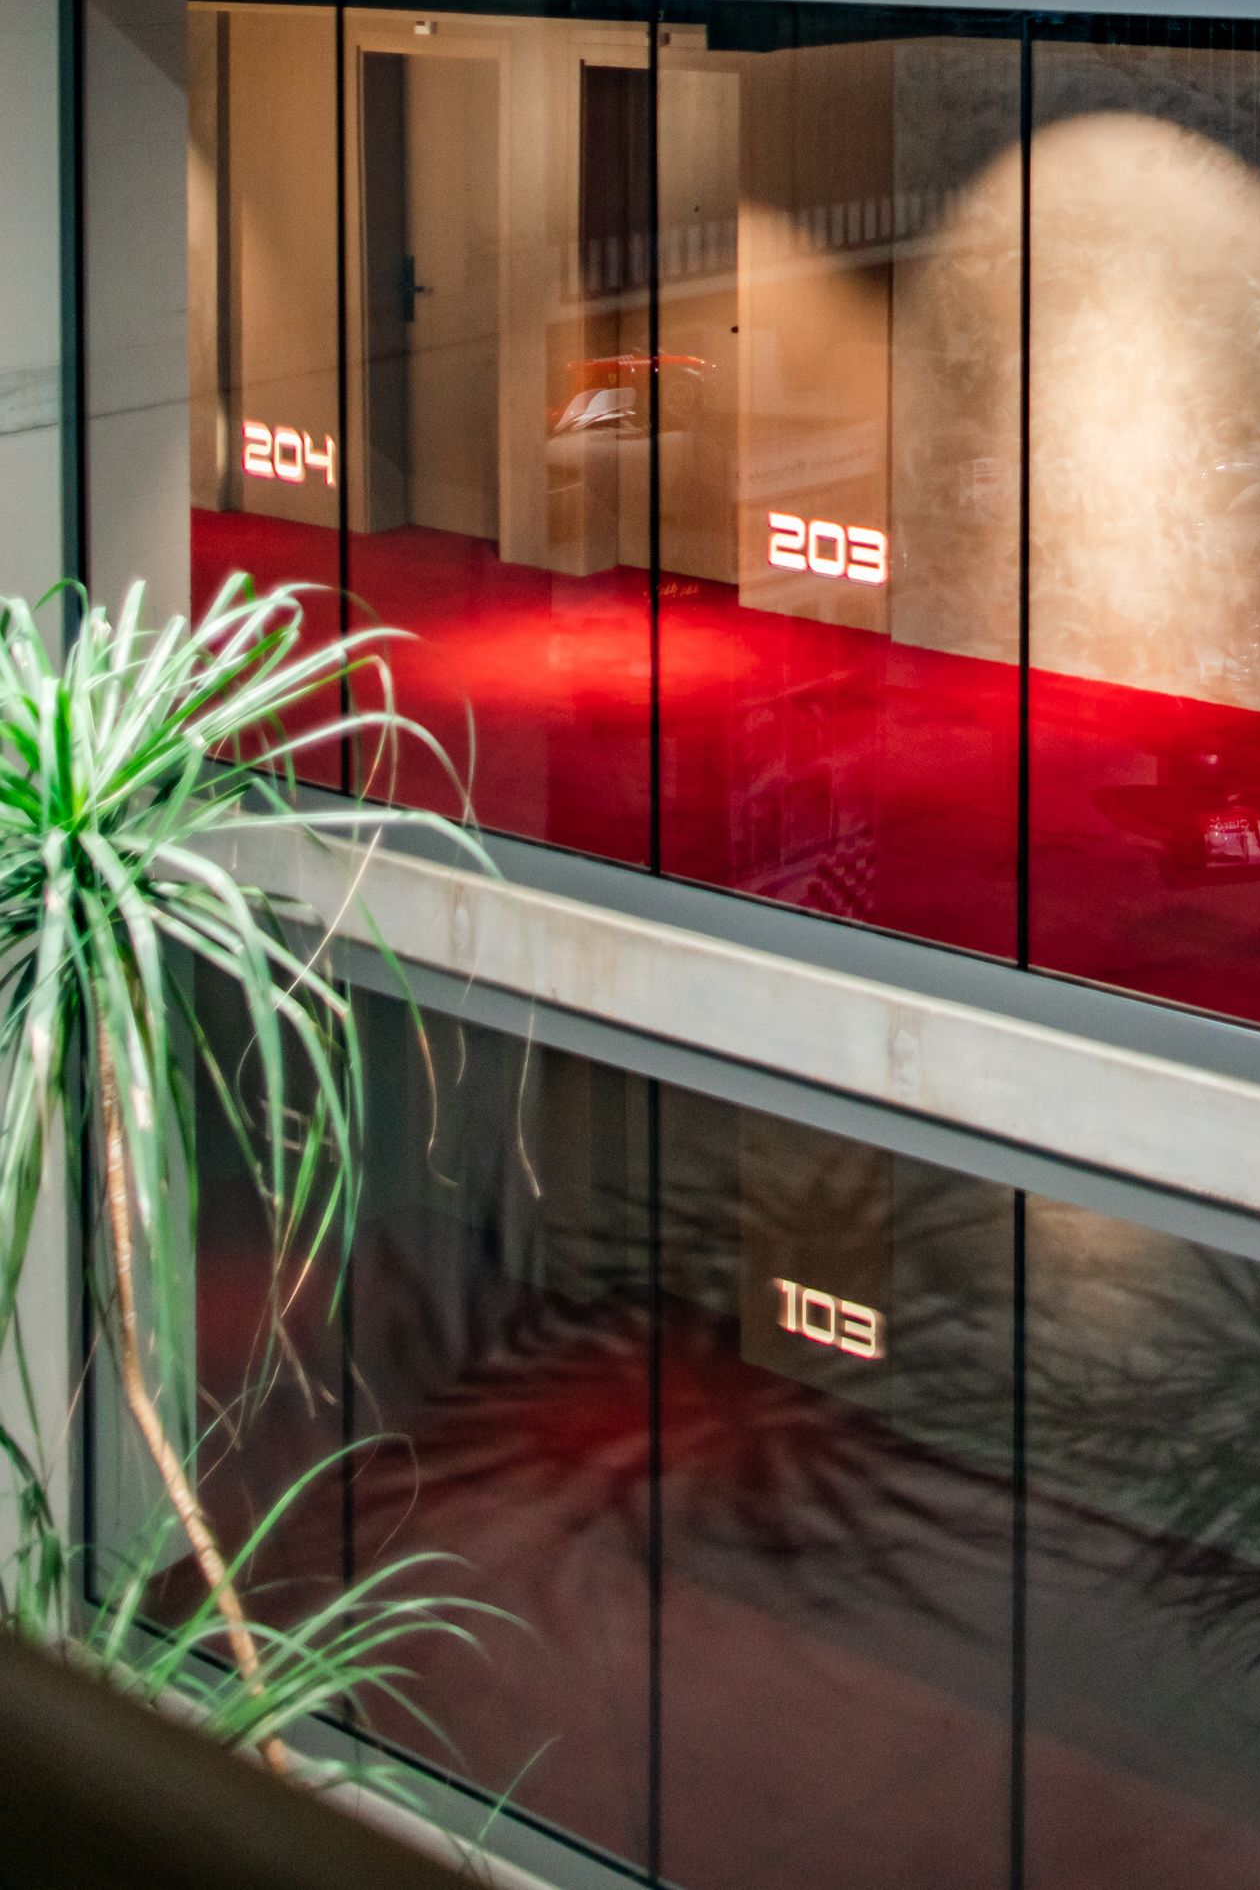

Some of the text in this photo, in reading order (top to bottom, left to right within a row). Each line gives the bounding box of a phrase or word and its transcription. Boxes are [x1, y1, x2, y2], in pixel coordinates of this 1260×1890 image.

[243, 419, 335, 487] 204
[768, 511, 889, 586] 203
[772, 1277, 885, 1360] 103
